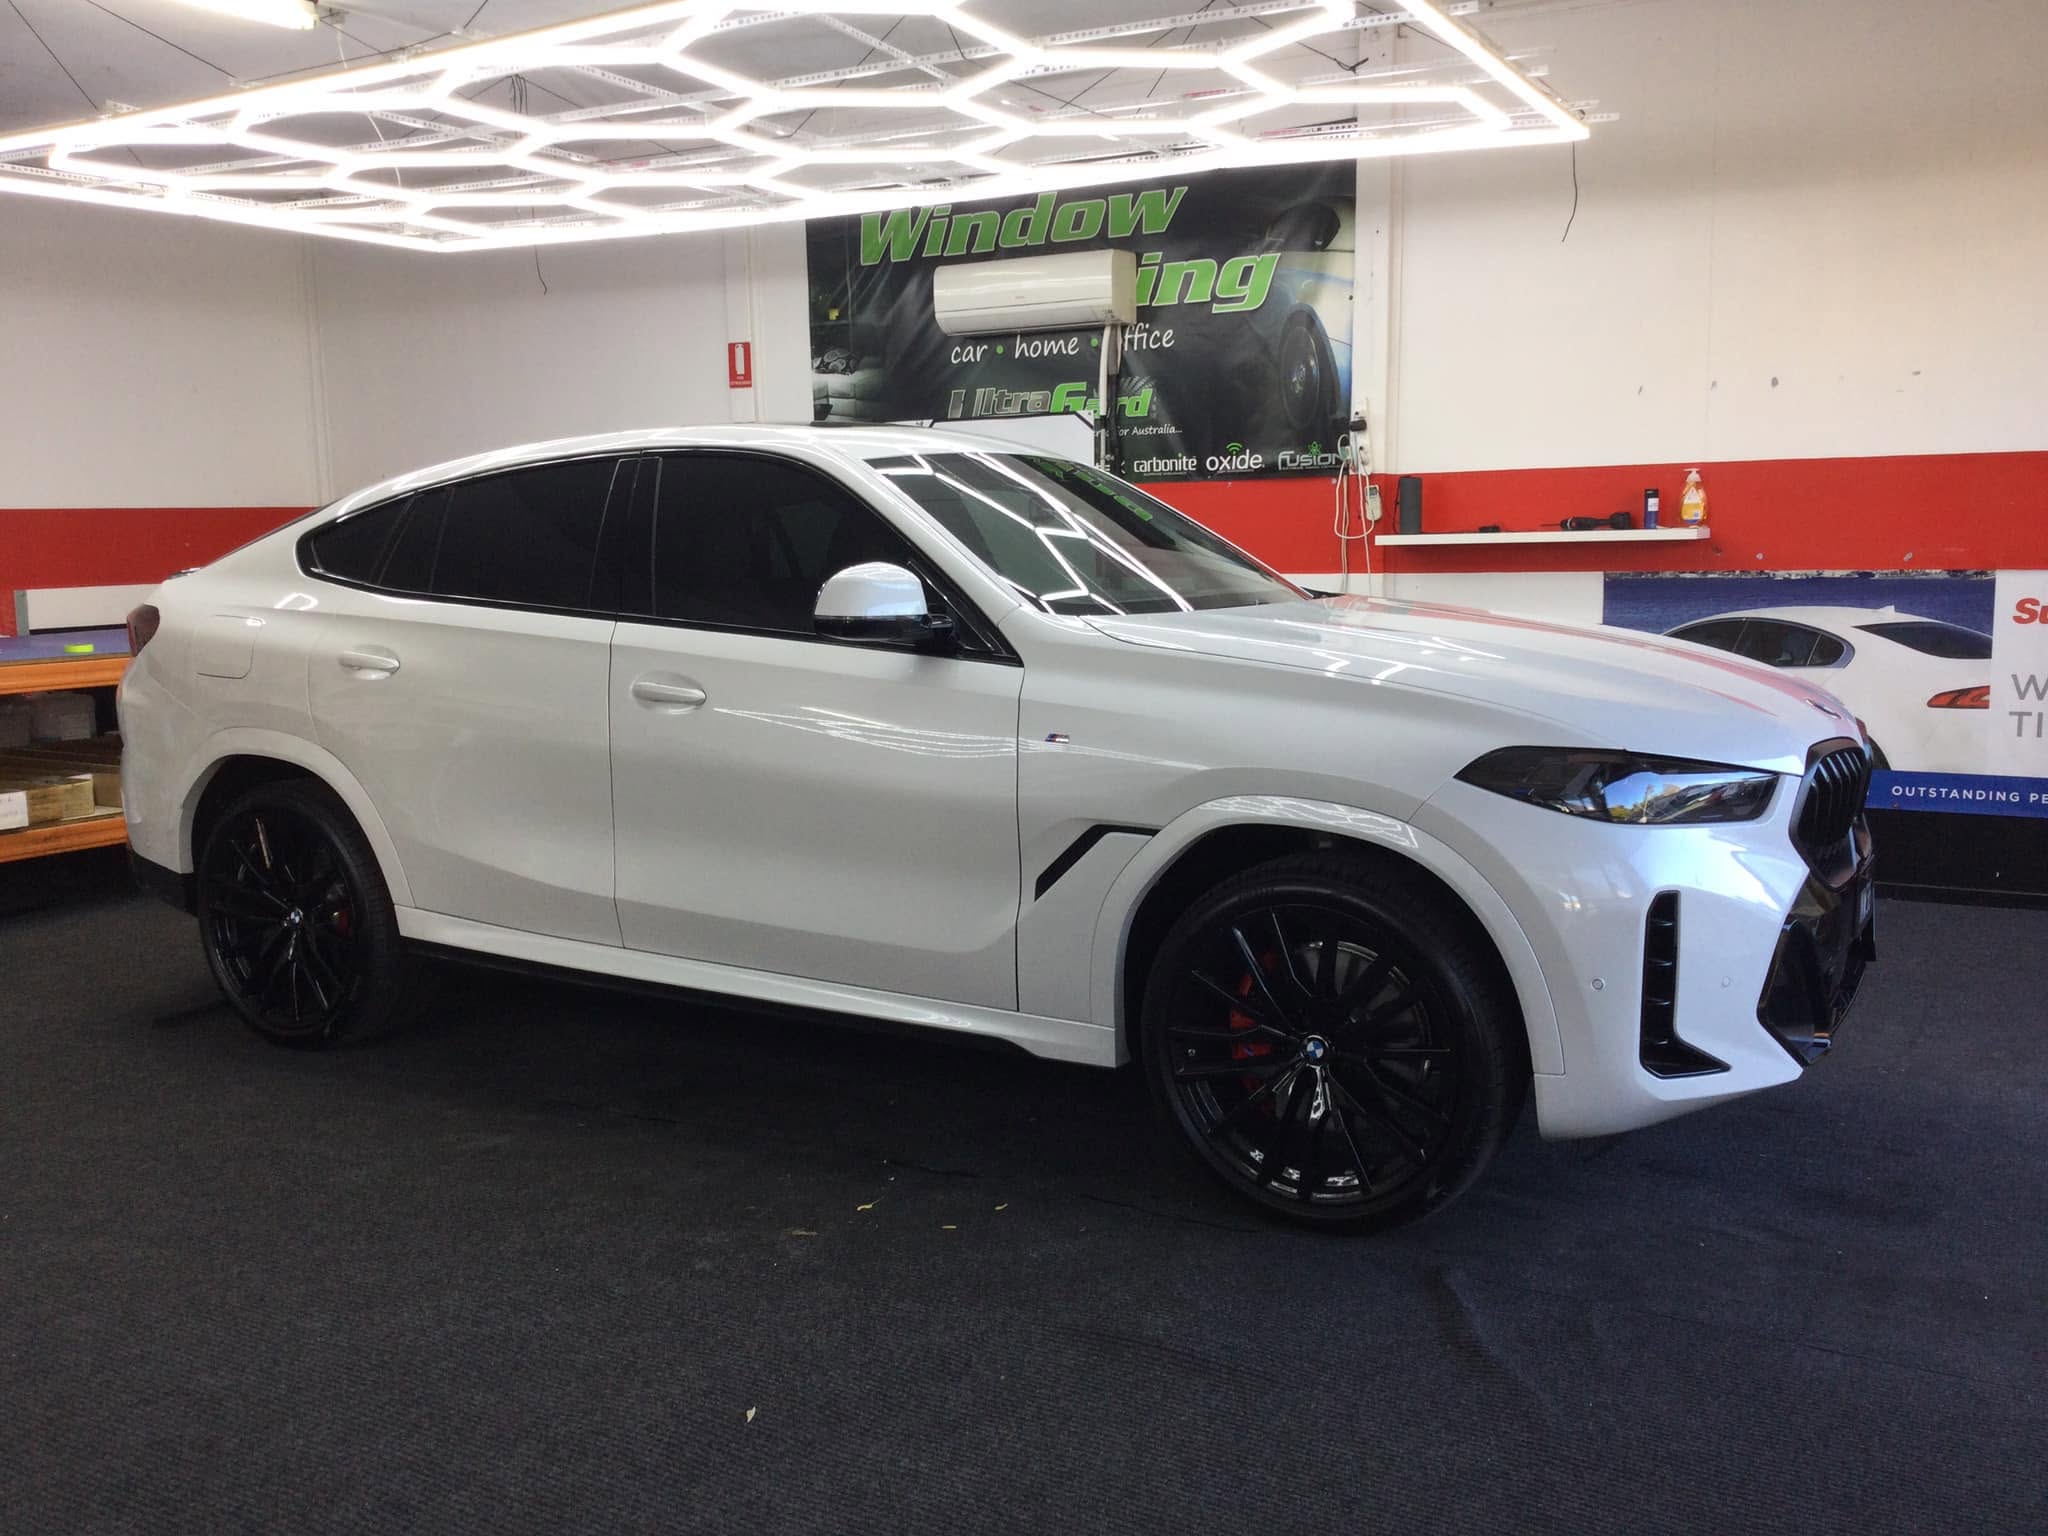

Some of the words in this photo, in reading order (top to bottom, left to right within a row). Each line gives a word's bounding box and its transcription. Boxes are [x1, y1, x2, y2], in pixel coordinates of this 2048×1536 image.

[860, 186, 1189, 266] Window
[951, 343, 988, 364] car
[1014, 331, 1080, 359] home
[1124, 322, 1175, 352] ffice
[1134, 452, 1198, 473] carbonite
[1206, 449, 1263, 471] oxide
[1892, 786, 2020, 802] OUTSTANDING
